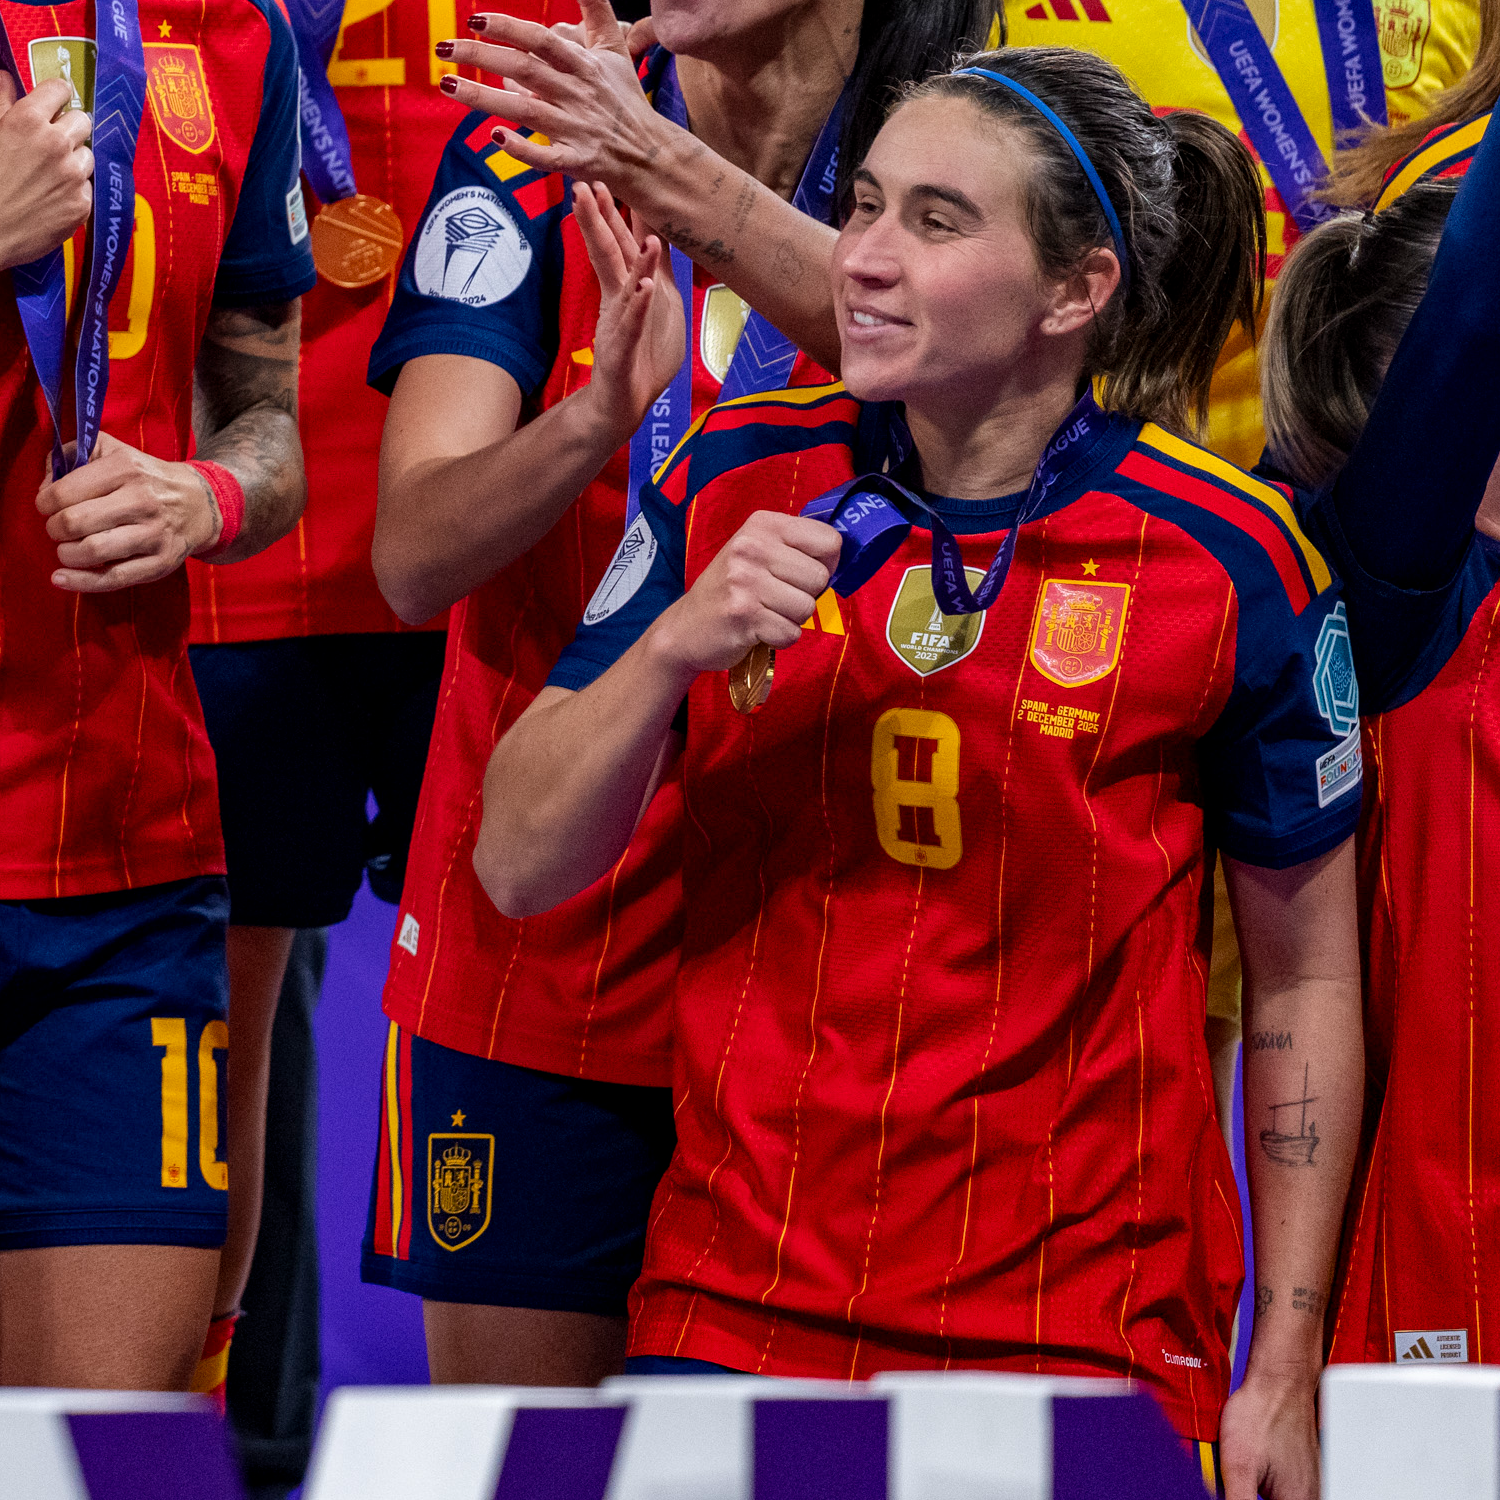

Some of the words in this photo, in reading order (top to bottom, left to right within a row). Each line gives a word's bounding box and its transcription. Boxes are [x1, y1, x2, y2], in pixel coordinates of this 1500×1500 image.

[1229, 39, 1263, 93] UEFA
[1346, 52, 1368, 108] UEFA
[109, 160, 123, 211] UEFA
[171, 171, 191, 183] SPAIN
[171, 182, 177, 192] 2
[425, 213, 439, 235] UEFA
[438, 190, 476, 213] WOMEN'S
[92, 216, 122, 317] WOMEN'S
[86, 318, 103, 424] NATIONS
[941, 541, 958, 594] UEFA
[900, 643, 922, 651] WORLD
[922, 645, 959, 655] CHAMPIONS
[910, 631, 951, 649] FIFA
[914, 650, 938, 661] 2023
[1017, 709, 1024, 720] 2
[1026, 710, 1075, 729] DECEMBER
[1076, 719, 1100, 734] 2025
[1020, 698, 1049, 714] SPAIN
[1056, 705, 1101, 723] GERMANY
[1039, 723, 1075, 740] MADRID
[871, 706, 964, 870] 8
